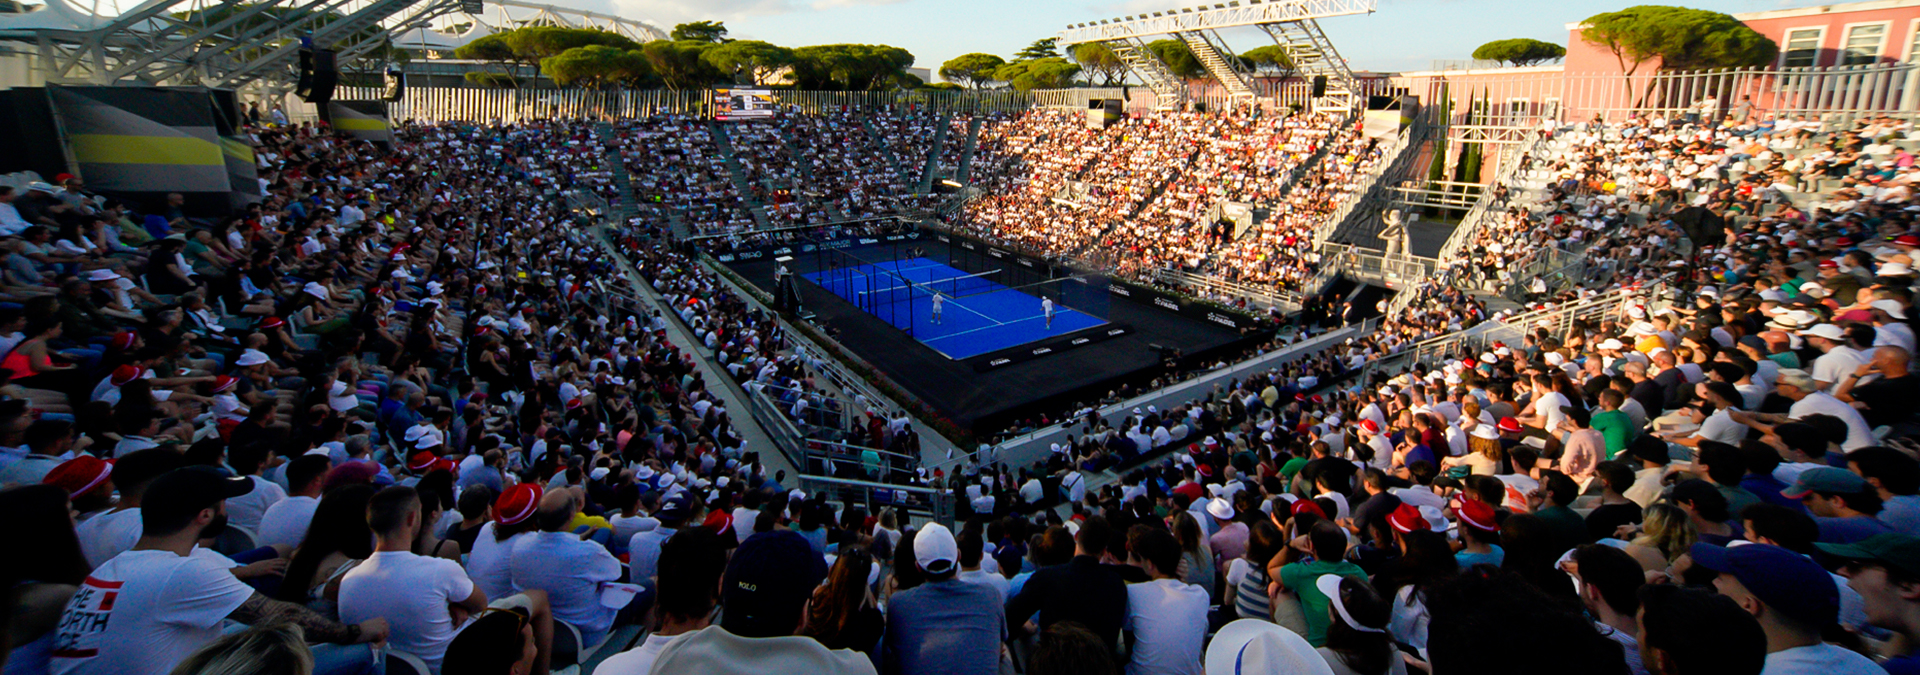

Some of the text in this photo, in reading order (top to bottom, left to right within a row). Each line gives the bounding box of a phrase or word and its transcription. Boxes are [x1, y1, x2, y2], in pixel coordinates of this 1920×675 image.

[1160, 300, 1179, 311] PADEL
[1213, 316, 1236, 328] PADEL
[71, 588, 96, 608] HE
[58, 609, 111, 632] ORTH
